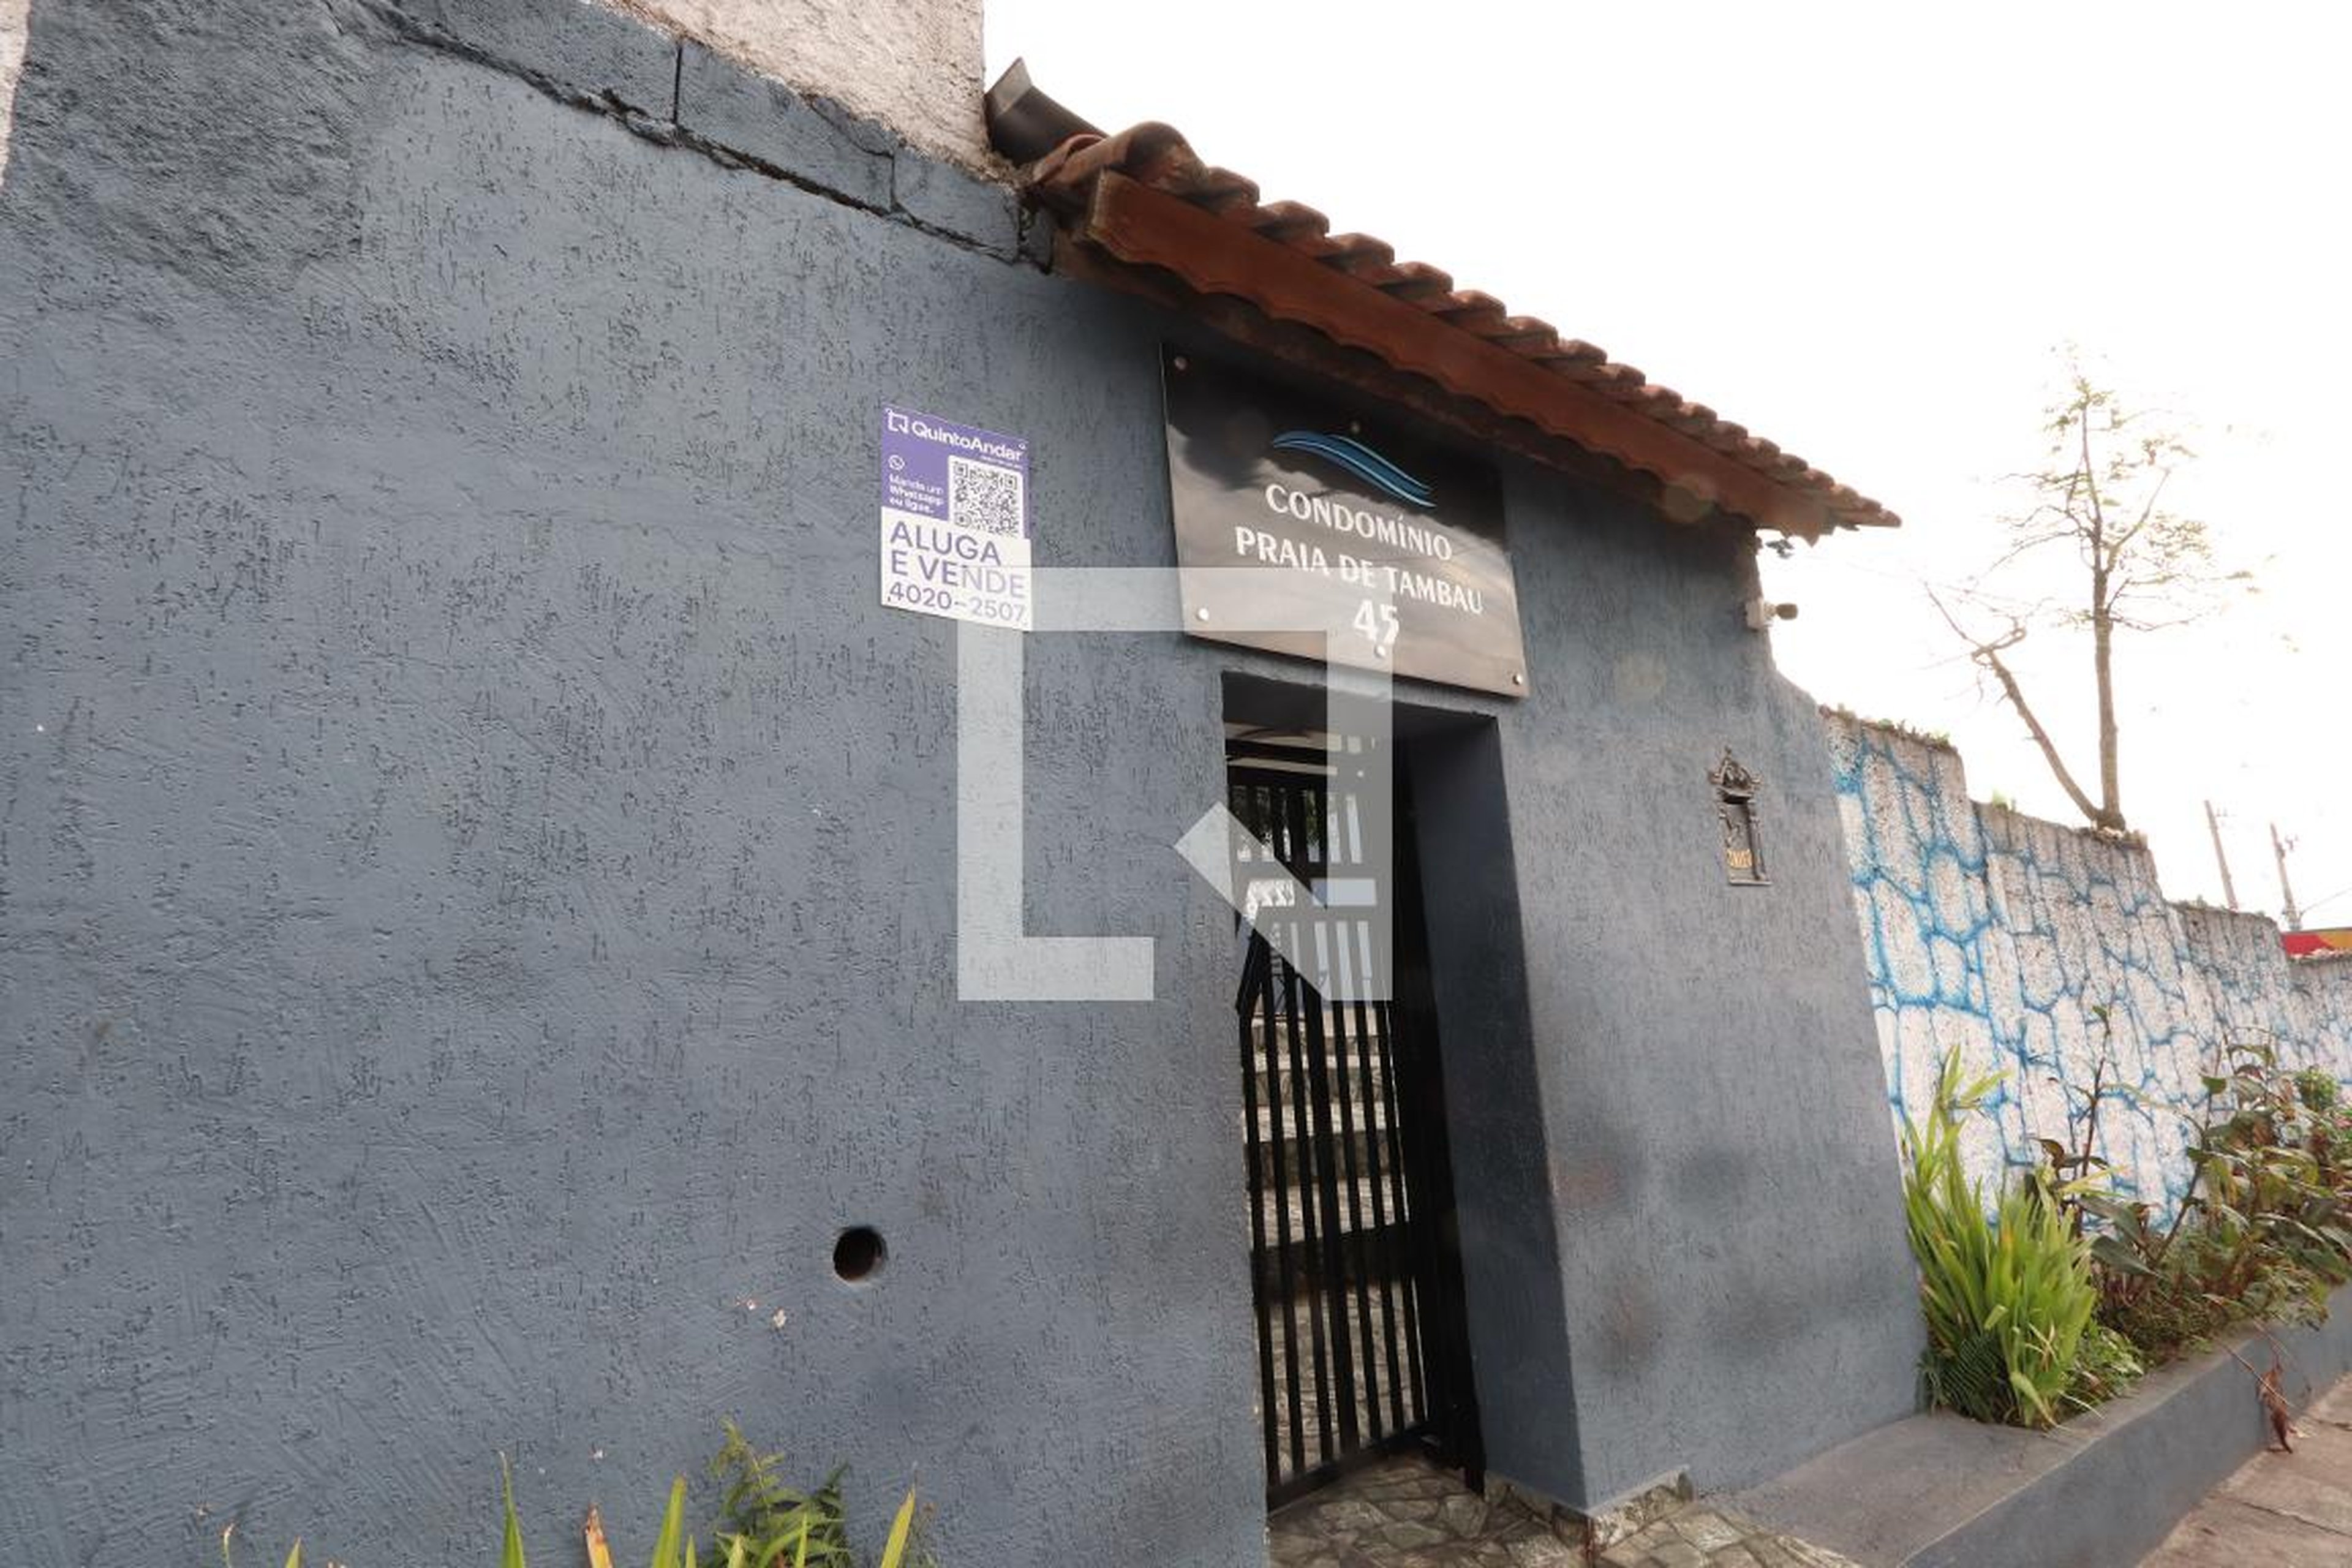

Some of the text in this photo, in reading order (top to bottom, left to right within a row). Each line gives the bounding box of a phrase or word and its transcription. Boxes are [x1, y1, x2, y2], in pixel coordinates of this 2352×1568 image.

[911, 421, 1024, 461] QuintoAndar
[890, 521, 1001, 567] ALUGA
[1265, 483, 1452, 560] CONDOMÍNIO
[892, 549, 1025, 598] E VENDE
[1235, 527, 1483, 614] PRAIA DE TAMBAU
[889, 582, 1026, 622] 4020-2507
[1354, 600, 1400, 646] 45
